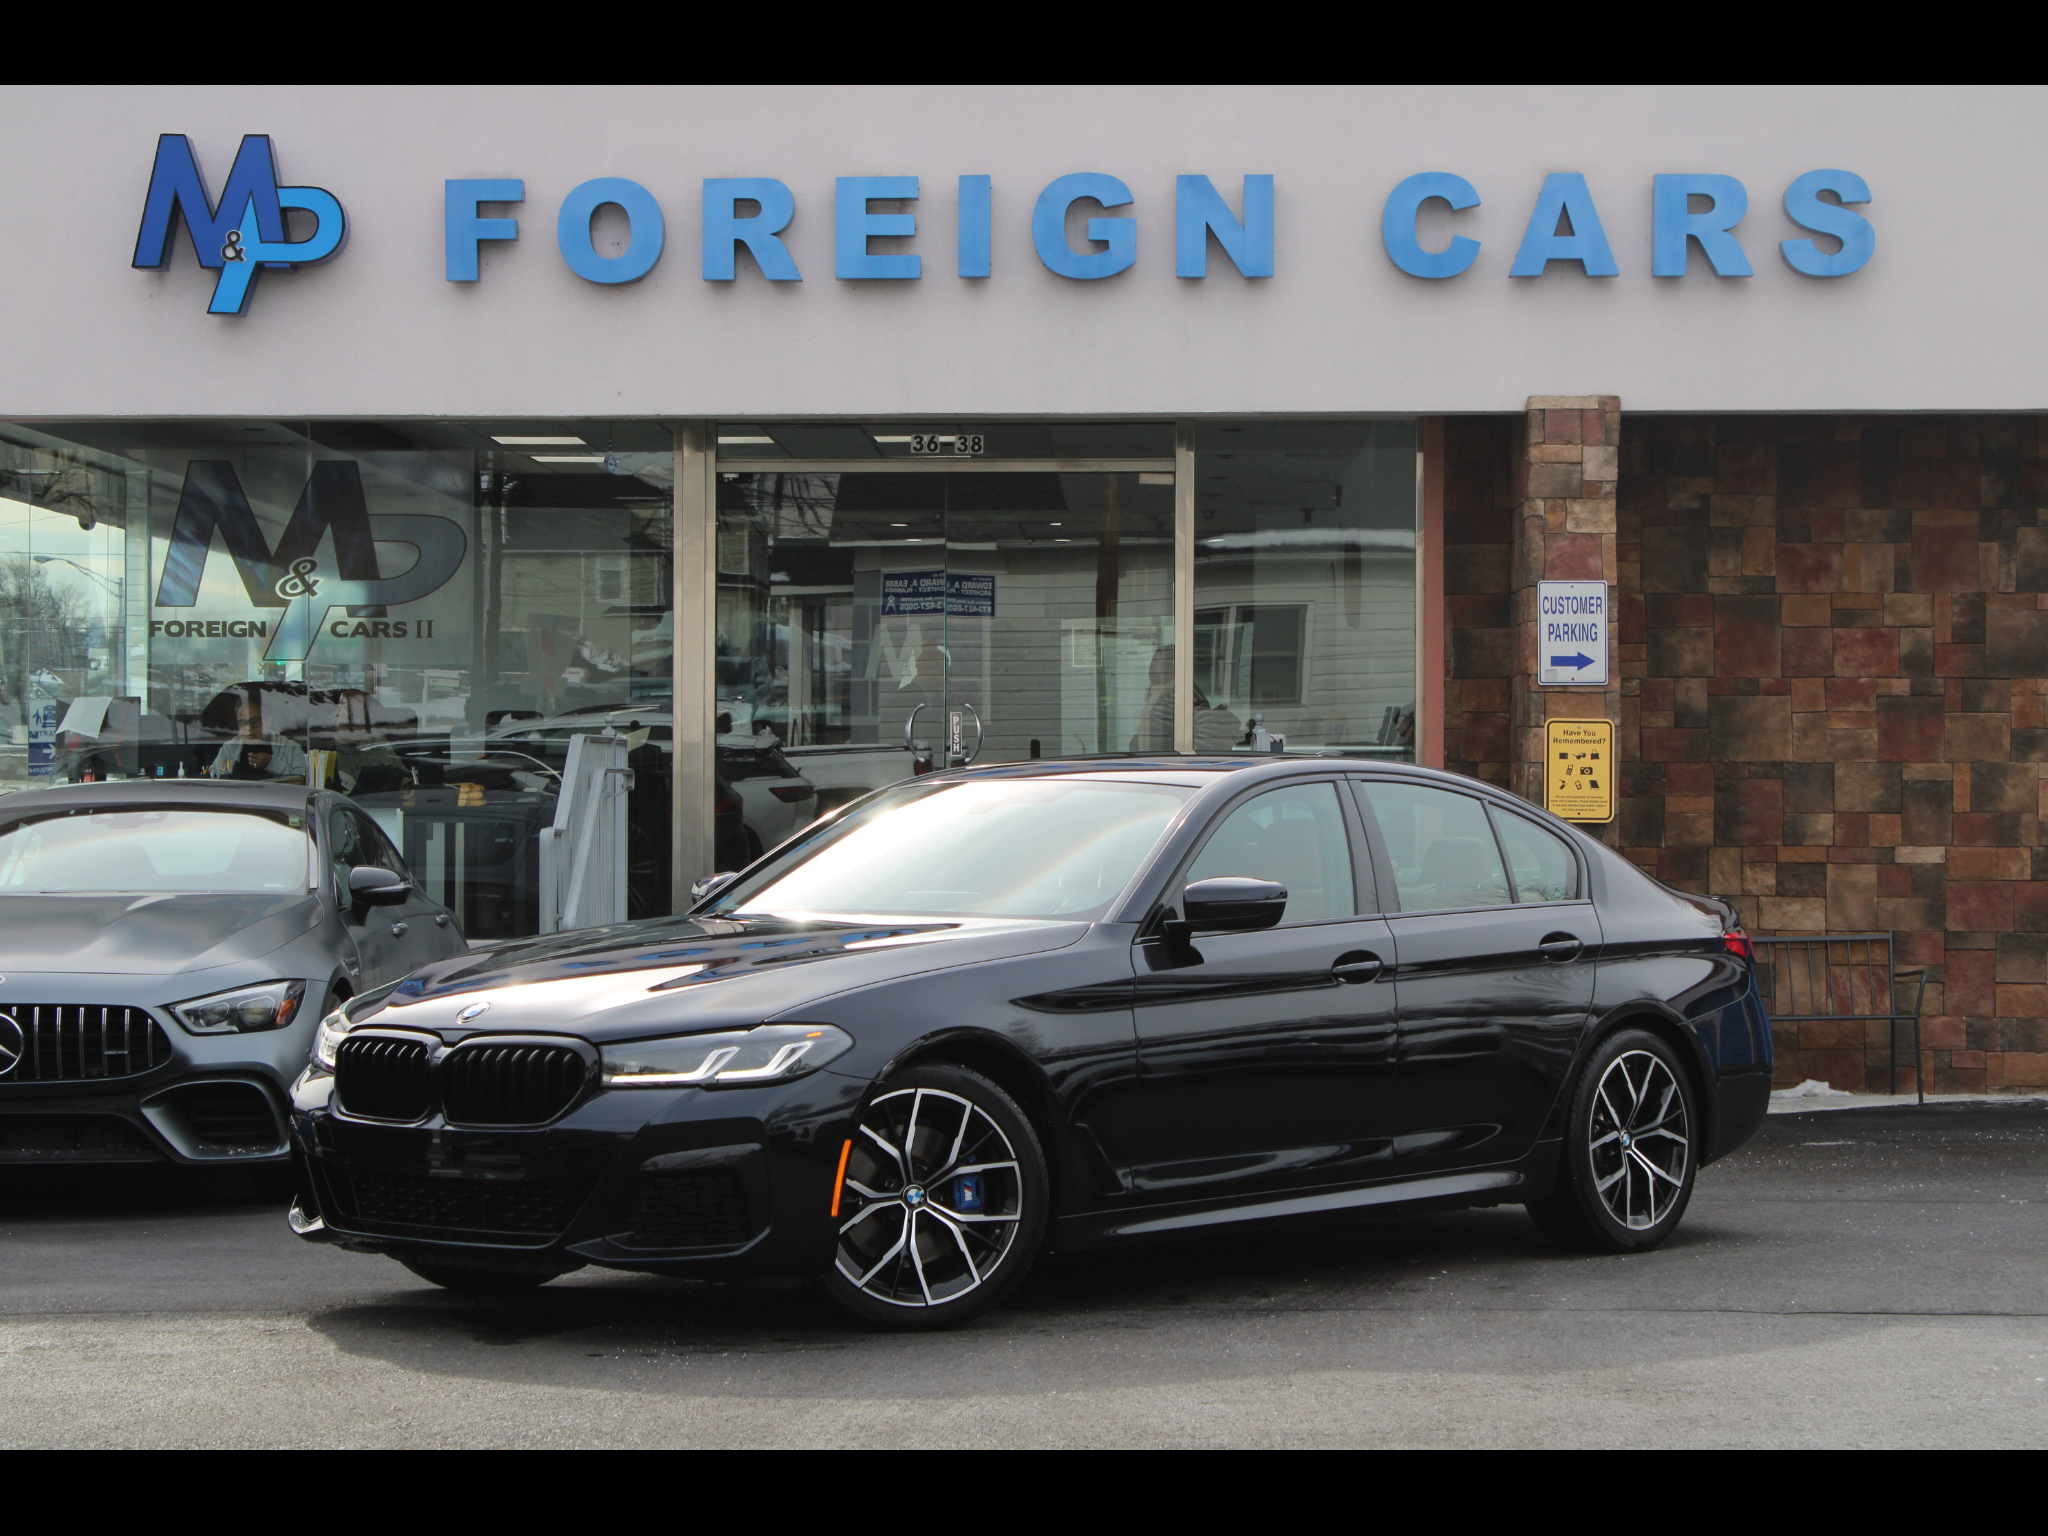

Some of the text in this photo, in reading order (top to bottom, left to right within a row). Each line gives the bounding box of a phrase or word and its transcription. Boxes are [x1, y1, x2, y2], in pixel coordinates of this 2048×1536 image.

[444, 168, 1876, 284] FOREIGN CARS
[1542, 596, 1603, 615] CUSTOMER
[149, 620, 267, 638] FOREIGN
[330, 620, 408, 639] CARS
[1548, 622, 1598, 642] PARKING
[1553, 737, 1606, 745] Remembered?
